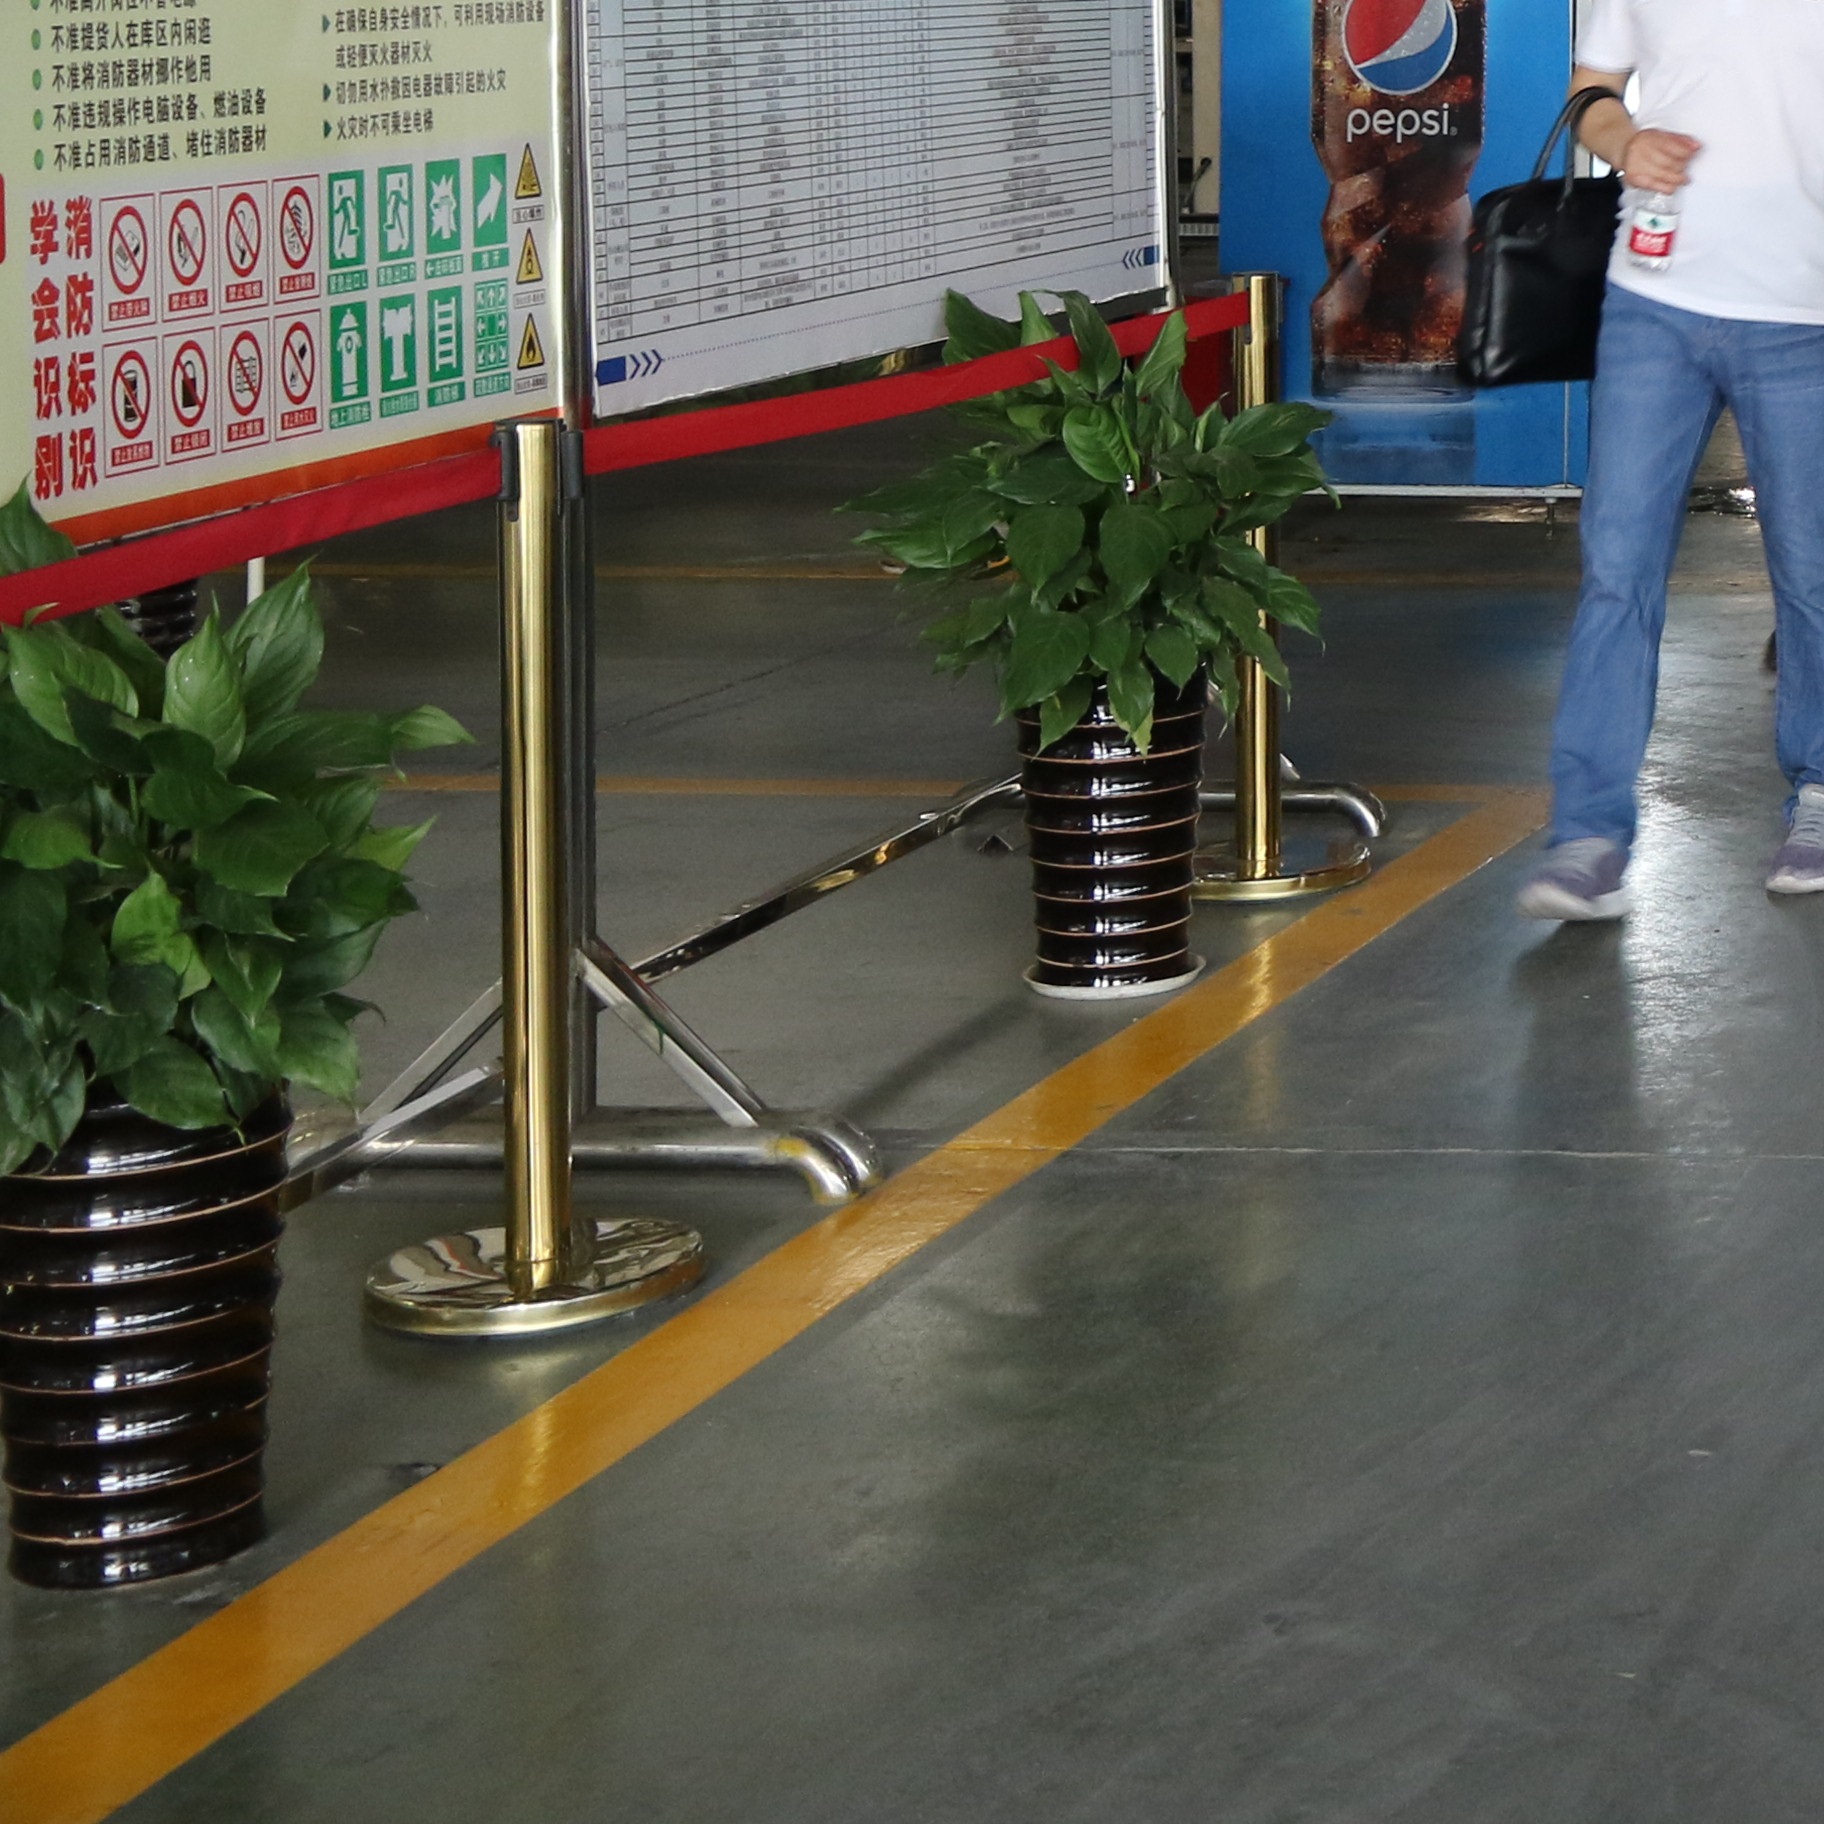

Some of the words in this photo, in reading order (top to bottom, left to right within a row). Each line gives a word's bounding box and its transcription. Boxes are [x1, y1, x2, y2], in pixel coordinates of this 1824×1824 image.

[1346, 103, 1451, 144] pepsi
[30, 199, 63, 502] 学会识别
[65, 194, 98, 490] 消防标识
